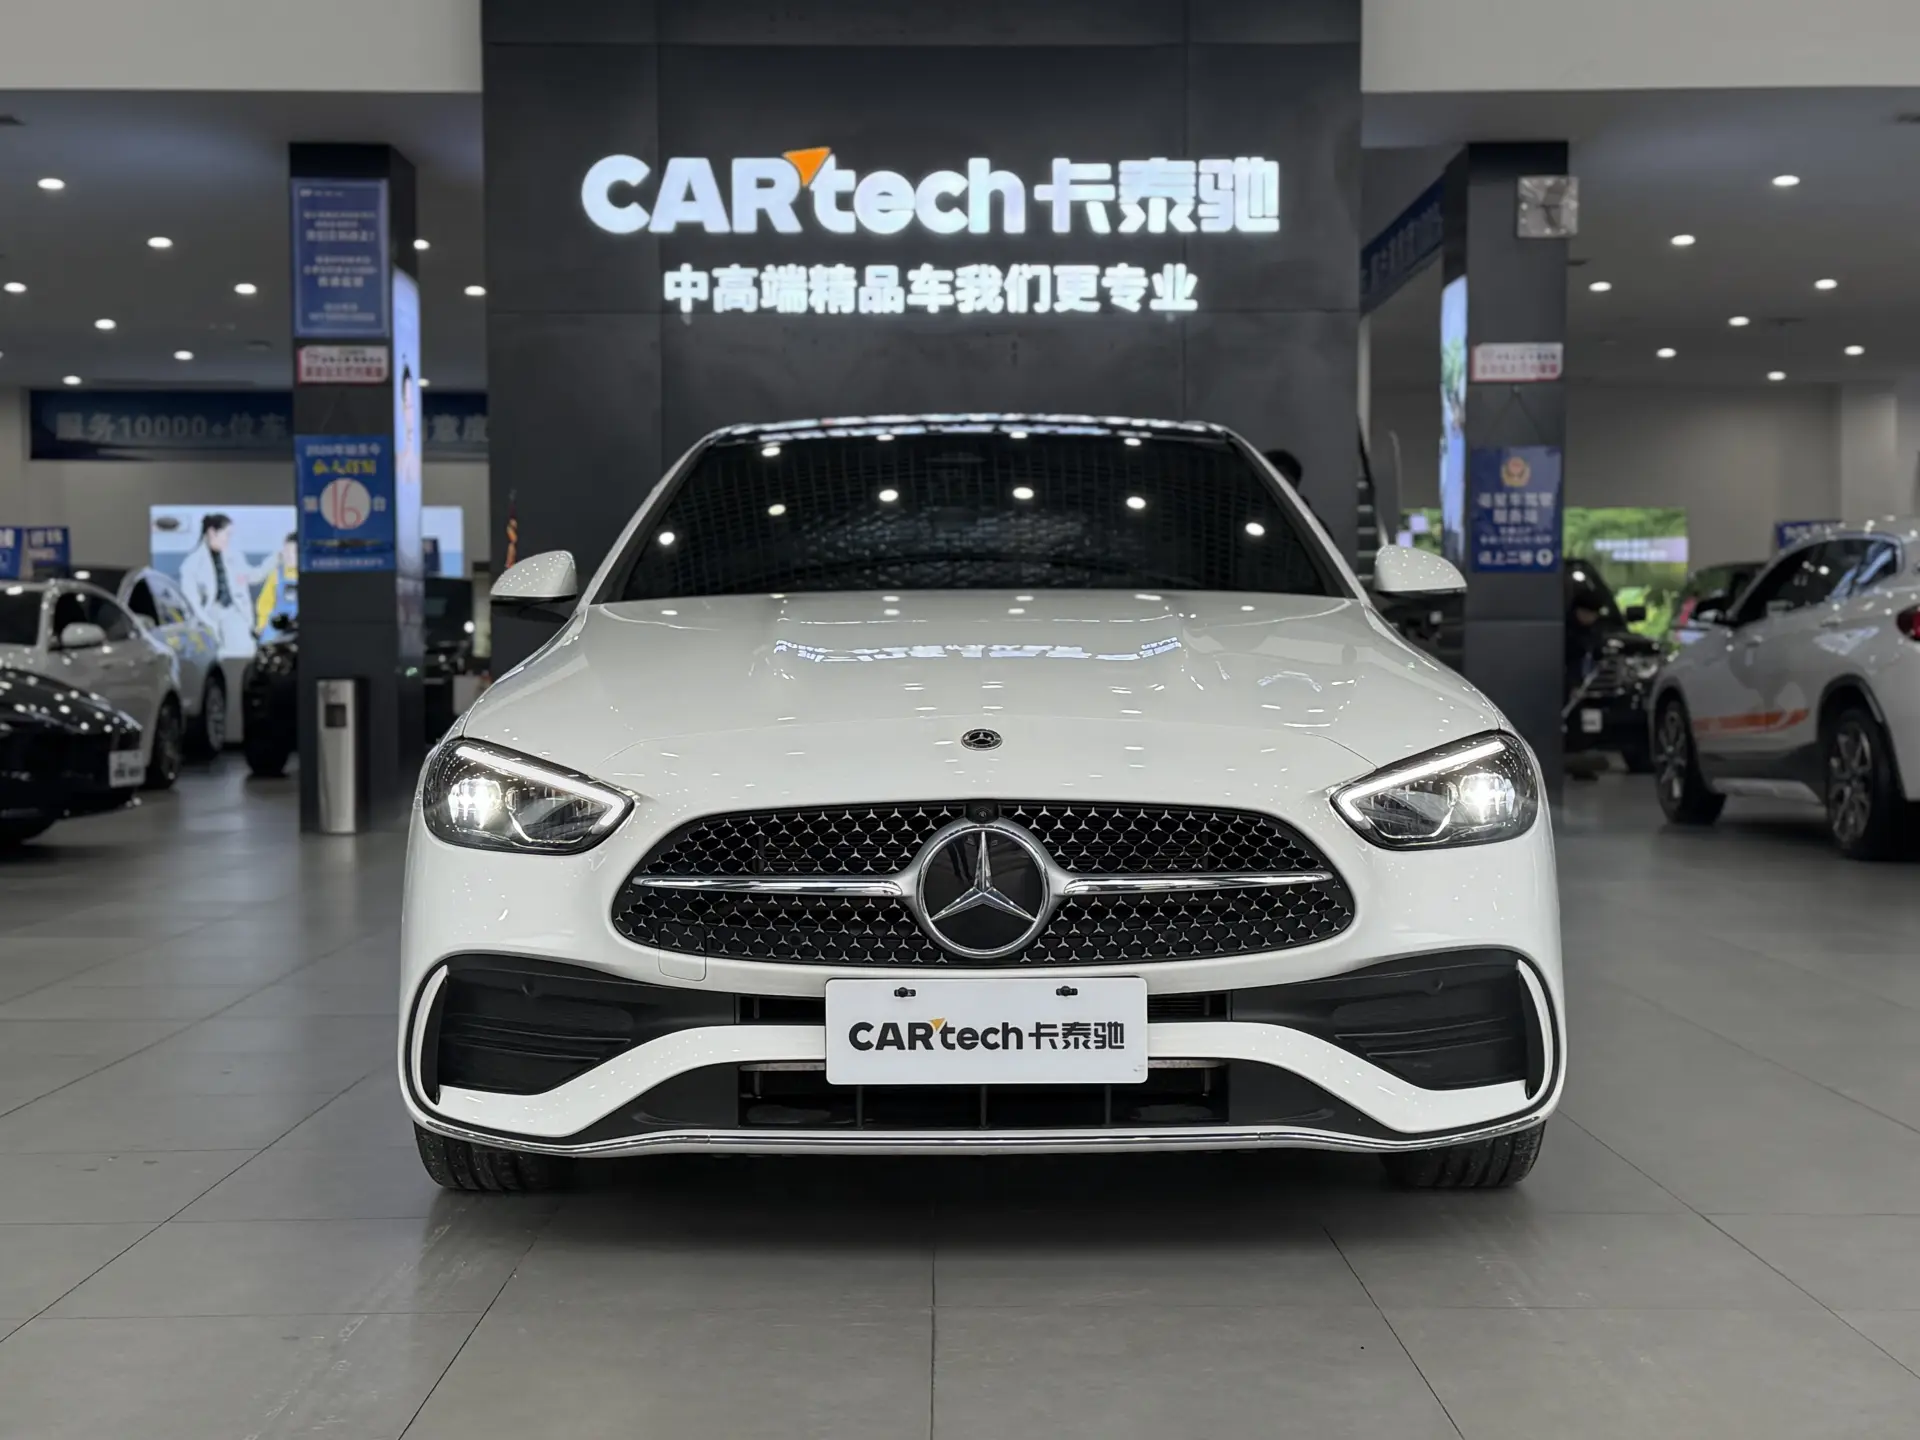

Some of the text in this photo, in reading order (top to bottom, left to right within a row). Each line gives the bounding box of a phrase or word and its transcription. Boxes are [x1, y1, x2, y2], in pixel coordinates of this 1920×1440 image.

[581, 153, 1280, 233] CARtech 卡泰驰
[663, 263, 1199, 314] 中高端精品车我们更专业
[848, 1021, 1125, 1051] CARtech 卡泰驰
